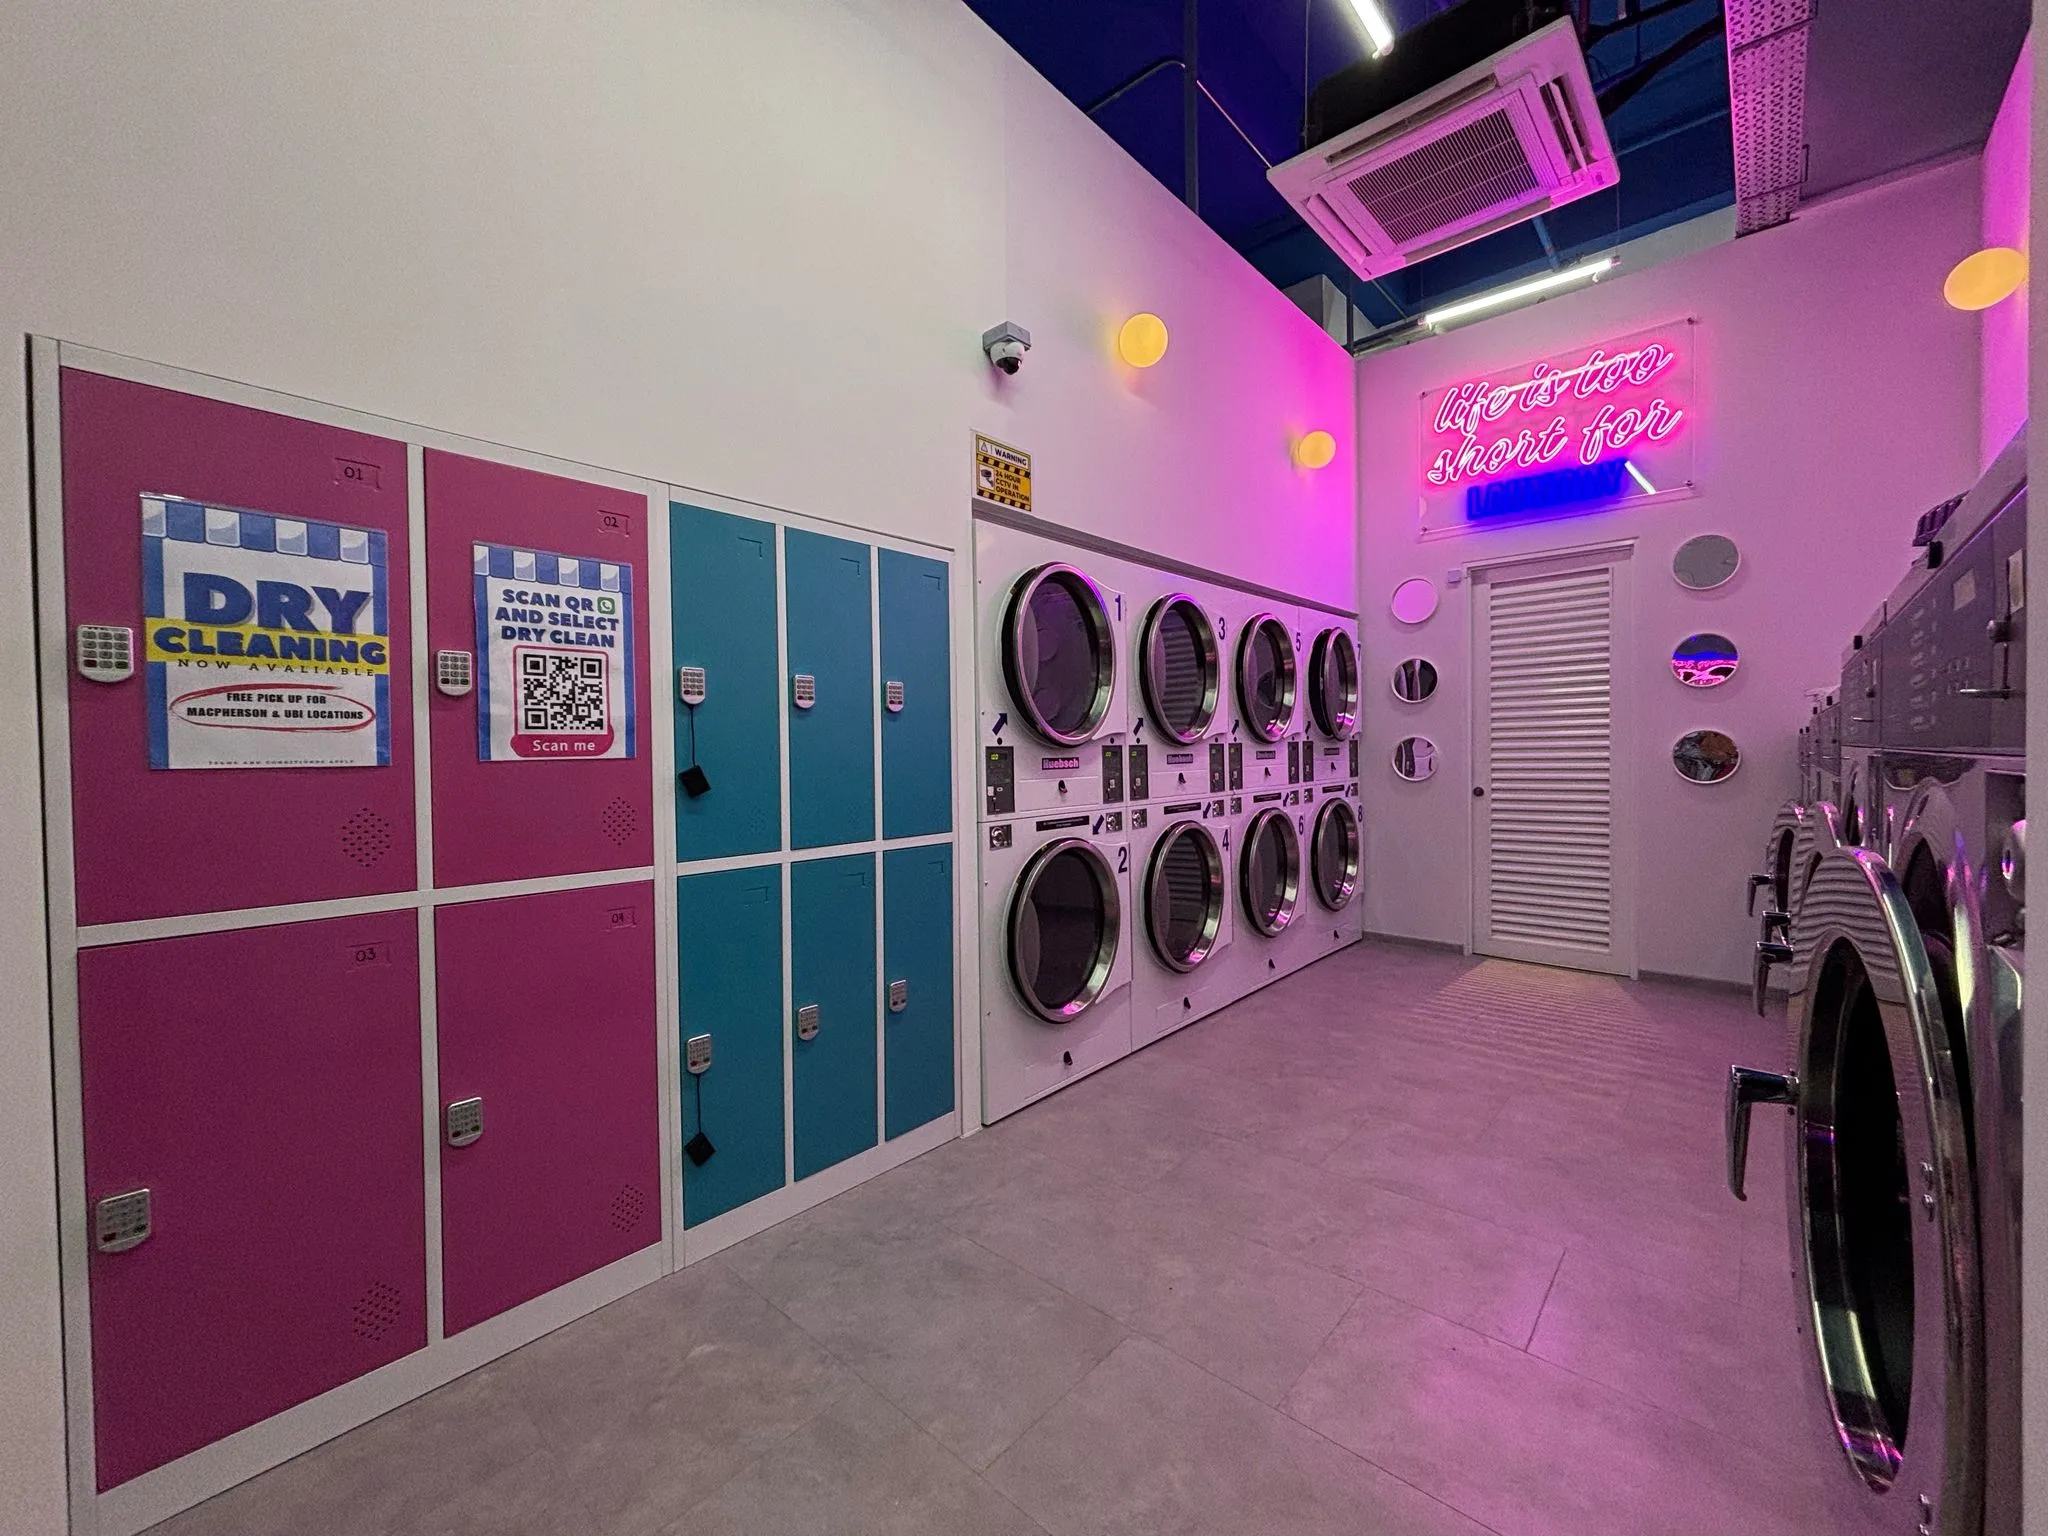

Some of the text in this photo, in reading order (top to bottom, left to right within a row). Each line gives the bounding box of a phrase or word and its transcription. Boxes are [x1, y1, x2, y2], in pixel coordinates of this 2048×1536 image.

[1434, 344, 1674, 436] life is too
[1427, 399, 1683, 485] short for
[994, 448, 1027, 466] WARNING
[343, 466, 363, 481] 01
[995, 478, 1011, 489] CCTV
[1004, 473, 1021, 485] HOUR
[995, 486, 1030, 502] OPERATION
[603, 515, 619, 528] 02
[184, 572, 373, 635] DRY
[502, 589, 594, 613] SCAN QR
[1114, 594, 1122, 622] 1
[495, 607, 620, 631] AND SELECT
[1218, 617, 1226, 640] 3
[153, 626, 387, 665] CLEANING
[501, 625, 615, 648] DRY CLEAN
[1295, 632, 1301, 652] 5
[178, 658, 374, 677] NOW AVALIABLE
[226, 692, 327, 705] FREE PICK UP FOR
[187, 707, 363, 720] MACPHERSON & UBI LOCATIONS
[532, 740, 596, 752] Scan me
[1043, 758, 1079, 769] Huebsch
[1298, 815, 1304, 835] 6
[1222, 829, 1229, 851] 4
[1118, 847, 1128, 874] 2
